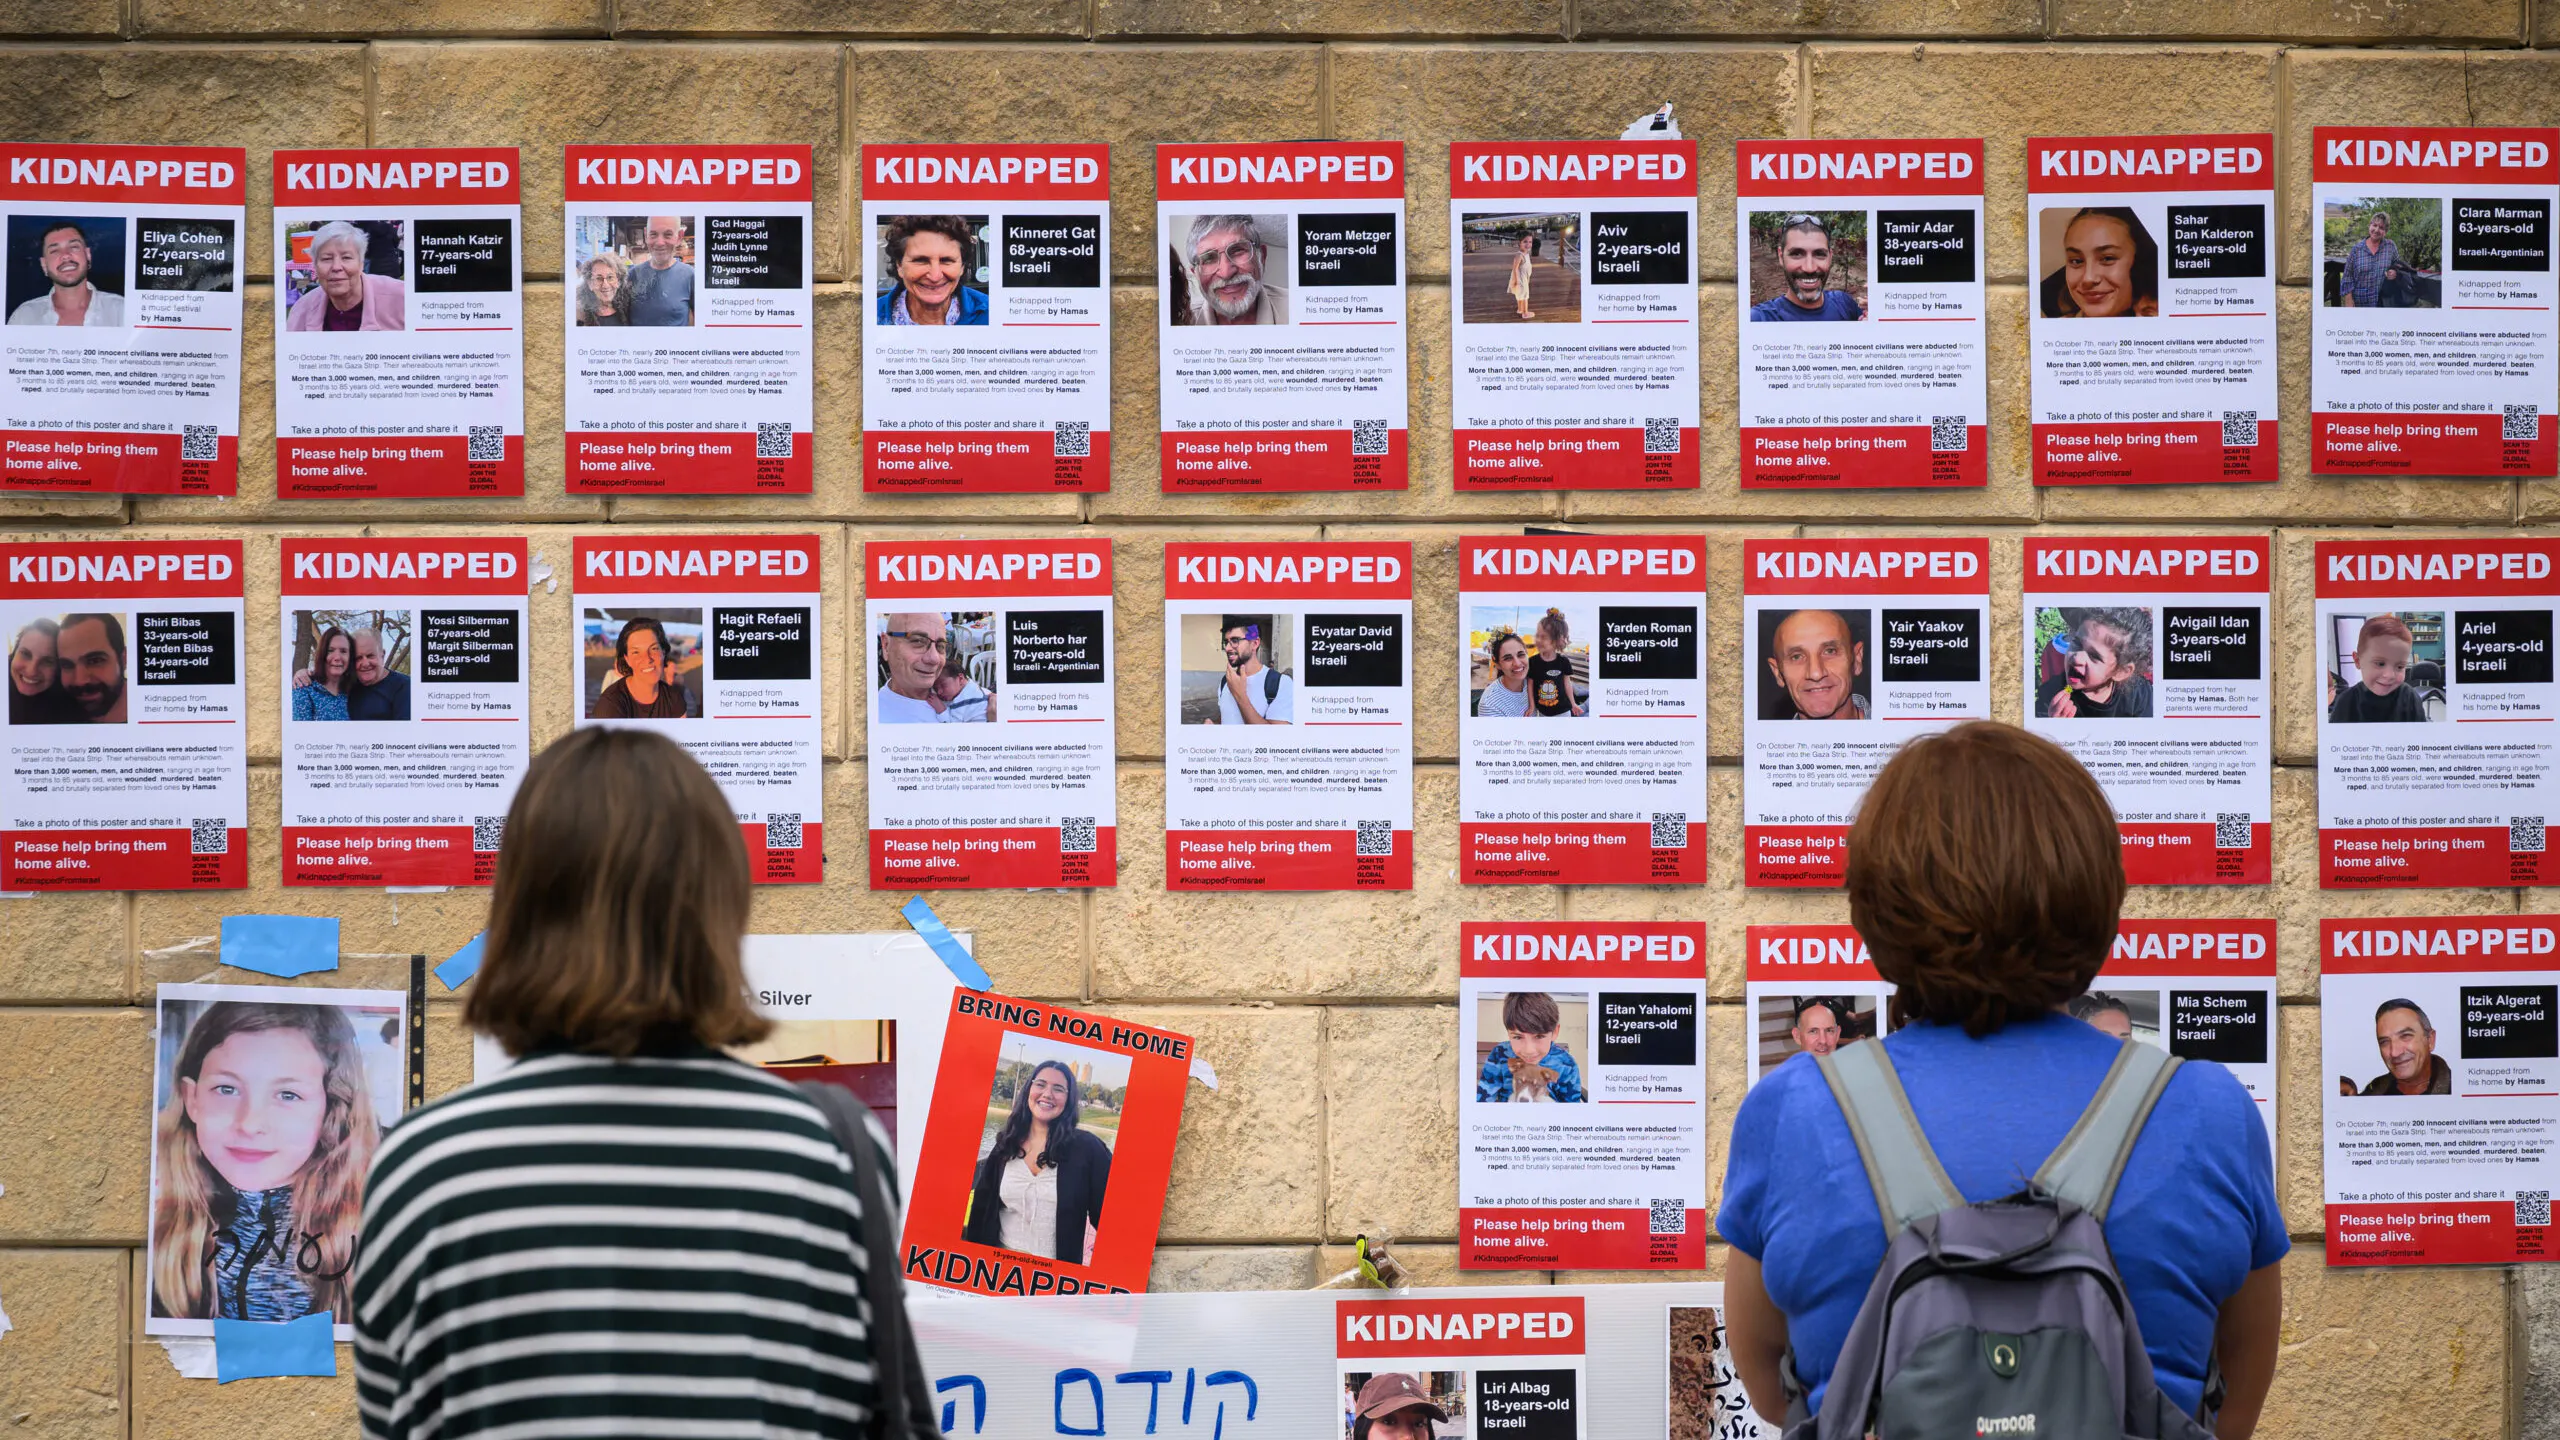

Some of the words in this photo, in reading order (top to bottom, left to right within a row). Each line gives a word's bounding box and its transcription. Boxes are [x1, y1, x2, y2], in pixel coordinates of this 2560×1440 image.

[2327, 140, 2548, 167] KIDNAPPED
[1464, 154, 1686, 181] KIDNAPPED
[1751, 153, 1972, 179] KIDNAPPED
[2042, 148, 2262, 176] KIDNAPPED
[11, 158, 234, 187] KIDNAPPED
[287, 162, 509, 189] KIDNAPPED
[579, 159, 800, 184] KIDNAPPED
[876, 158, 1098, 183] KIDNAPPED
[1171, 156, 1393, 183] KIDNAPPED
[2460, 207, 2490, 217] Clara
[2495, 208, 2542, 218] Marman
[733, 220, 765, 229] Haggai
[2175, 215, 2208, 224] Sahar
[1010, 227, 1067, 238] Kinneret
[1072, 227, 1095, 238] Gat
[1598, 225, 1628, 236] Aviv
[1884, 222, 1920, 233] Tamir
[1923, 222, 1954, 232] Adar
[2460, 223, 2533, 235] 63-years-old
[144, 231, 176, 245] Eliya
[180, 232, 222, 244] Cohen
[422, 235, 465, 245] Hannah
[469, 235, 503, 244] Katzir
[712, 231, 768, 241] 73-years-old
[1305, 231, 1342, 240] Yoram
[1346, 230, 1391, 242] Metzger
[2175, 230, 2197, 239] Dan
[2201, 229, 2253, 239] Kalderon
[740, 243, 767, 252] Lynne
[1010, 244, 1093, 258] 68-years-old
[1306, 245, 1376, 257] 80-years-old
[1598, 242, 1680, 258] 2-years-old
[1885, 238, 1963, 252] 38-years-old
[2176, 243, 2246, 256] 16-years-old
[143, 248, 225, 262] 27-years-old
[421, 250, 492, 262] 77-years-old
[712, 254, 756, 262] Weinstein
[2459, 248, 2543, 258] Israeli-Argentinian
[1306, 260, 1340, 269] Israeli
[1885, 254, 1923, 265] Israeli
[2176, 258, 2210, 268] Israeli
[143, 264, 182, 276] Israeli
[422, 264, 456, 274] Israeli
[712, 265, 768, 276] 70-years-old
[1010, 262, 1050, 273] Israeli
[1599, 261, 1639, 272] Israeli
[712, 277, 739, 285] Israeli
[878, 442, 921, 452] Please
[926, 442, 954, 455] help
[959, 442, 992, 455] bring
[997, 442, 1029, 453] them
[878, 459, 914, 469] home
[919, 459, 952, 469] alive.
[877, 477, 963, 487] #KidnappedFromIsrael
[295, 553, 516, 578] KIDNAPPED
[586, 550, 808, 576] KIDNAPPED
[879, 553, 1101, 581] KIDNAPPED
[1474, 549, 1695, 574] KIDNAPPED
[1757, 552, 1978, 577] KIDNAPPED
[2037, 550, 2258, 575] KIDNAPPED
[2329, 553, 2550, 581] KIDNAPPED
[10, 555, 232, 582] KIDNAPPED
[1179, 557, 1400, 582] KIDNAPPED
[144, 618, 168, 627] Shiri
[171, 618, 201, 626] Bibas
[428, 616, 455, 625] Yossi
[458, 616, 509, 625] Silberman
[720, 614, 753, 627] Hagit
[758, 613, 801, 624] Refaeli
[1013, 620, 1038, 630] Luis
[2170, 616, 2216, 630] Avigail
[2221, 616, 2249, 627] Idan
[1312, 626, 1356, 638] Evyatar
[1360, 626, 1392, 636] David
[1607, 623, 1647, 632] Yarden
[1651, 623, 1691, 632] Roman
[1889, 621, 1914, 632] Yair
[1918, 621, 1964, 632] Yaakov
[2462, 622, 2495, 634] Ariel
[144, 631, 208, 642] 33-years-old
[428, 629, 490, 639] 67-years-old
[720, 629, 799, 643] 48-years-old
[1014, 635, 1064, 645] Norberto
[1068, 635, 1087, 644] har
[2171, 633, 2246, 647] 3-years-old
[144, 644, 180, 653] Yarden
[184, 644, 213, 652] Bibas
[428, 642, 459, 652] Margit
[463, 642, 513, 650] Silberman
[1312, 641, 1383, 653] 22-years-old
[1607, 637, 1678, 649] 36-years-old
[1890, 637, 1968, 650] 59-years-old
[2463, 640, 2543, 655] 4-years-old
[721, 646, 758, 656] Israeli
[1013, 649, 1085, 662] 70-years-old
[1607, 652, 1641, 662] Israeli
[2171, 651, 2211, 662] Israeli
[144, 657, 208, 668] 34-years-old
[428, 654, 490, 665] 63-years-old
[1312, 656, 1346, 665] Israeli
[1890, 654, 1928, 664] Israeli
[2463, 659, 2506, 670] Israeli
[428, 667, 458, 675] Israeli
[1048, 662, 1099, 672] Argentinian
[145, 670, 176, 679] Israeli
[1474, 935, 1694, 961] KIDNAPPED
[2113, 934, 2267, 959] NAPPED
[2334, 928, 2555, 957] KIDNAPPED
[1760, 939, 1873, 964] KIDNA
[760, 990, 812, 1005] Silver
[2178, 997, 2199, 1007] Mia
[2203, 997, 2246, 1007] Schem
[2468, 995, 2493, 1006] Itzik
[2496, 995, 2541, 1008] Algerat
[1606, 1004, 1635, 1014] Eitan
[1639, 1005, 1692, 1014] Yahalomi
[2177, 1013, 2255, 1026] 21-years-old
[2468, 1010, 2544, 1023] 69-years-old
[958, 994, 1041, 1027] BRING
[1048, 1013, 1104, 1042] NOA
[1111, 1026, 1188, 1060] HOME
[1606, 1019, 1677, 1031] 12-years-old
[2177, 1029, 2215, 1039] Israeli
[2468, 1026, 2505, 1037] Israeli
[1606, 1034, 1640, 1043] Israeli
[1474, 1197, 1494, 1205] Take
[1505, 1197, 1529, 1207] photo
[1532, 1197, 1539, 1205] of
[1542, 1197, 1557, 1205] this
[1560, 1198, 1586, 1207] poster
[1589, 1198, 1605, 1206] and
[1608, 1198, 1632, 1206] share
[1634, 1198, 1640, 1206] it
[906, 1244, 1132, 1297] KIDNAPPE
[1347, 1313, 1573, 1341] KIDNAPPED
[1484, 1383, 1505, 1394] Liri
[1510, 1382, 1549, 1396] Albag
[1485, 1399, 1569, 1413] 18-years-old
[1485, 1416, 1525, 1428] Israeli
[1976, 1413, 2036, 1434] OUTDOOR
